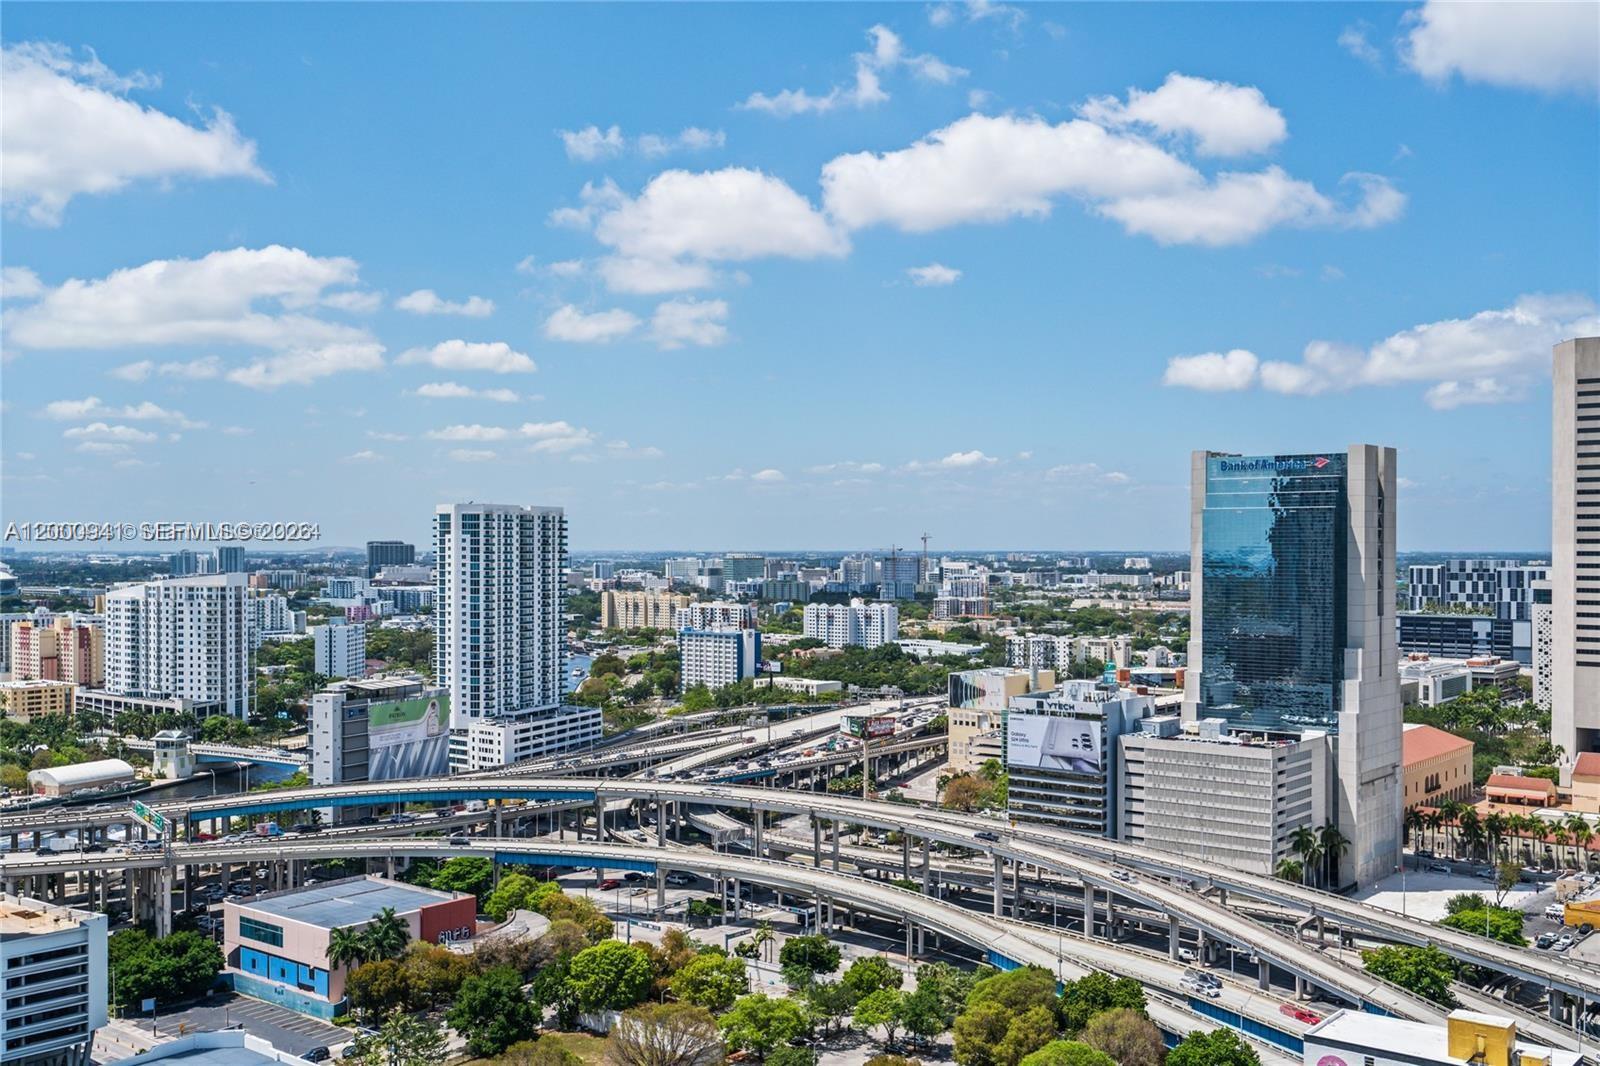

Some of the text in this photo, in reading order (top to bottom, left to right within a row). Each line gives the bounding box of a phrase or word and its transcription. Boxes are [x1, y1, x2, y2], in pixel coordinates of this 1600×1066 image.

[1220, 458, 1307, 471] Bank of America
[1046, 701, 1075, 711] YTECH
